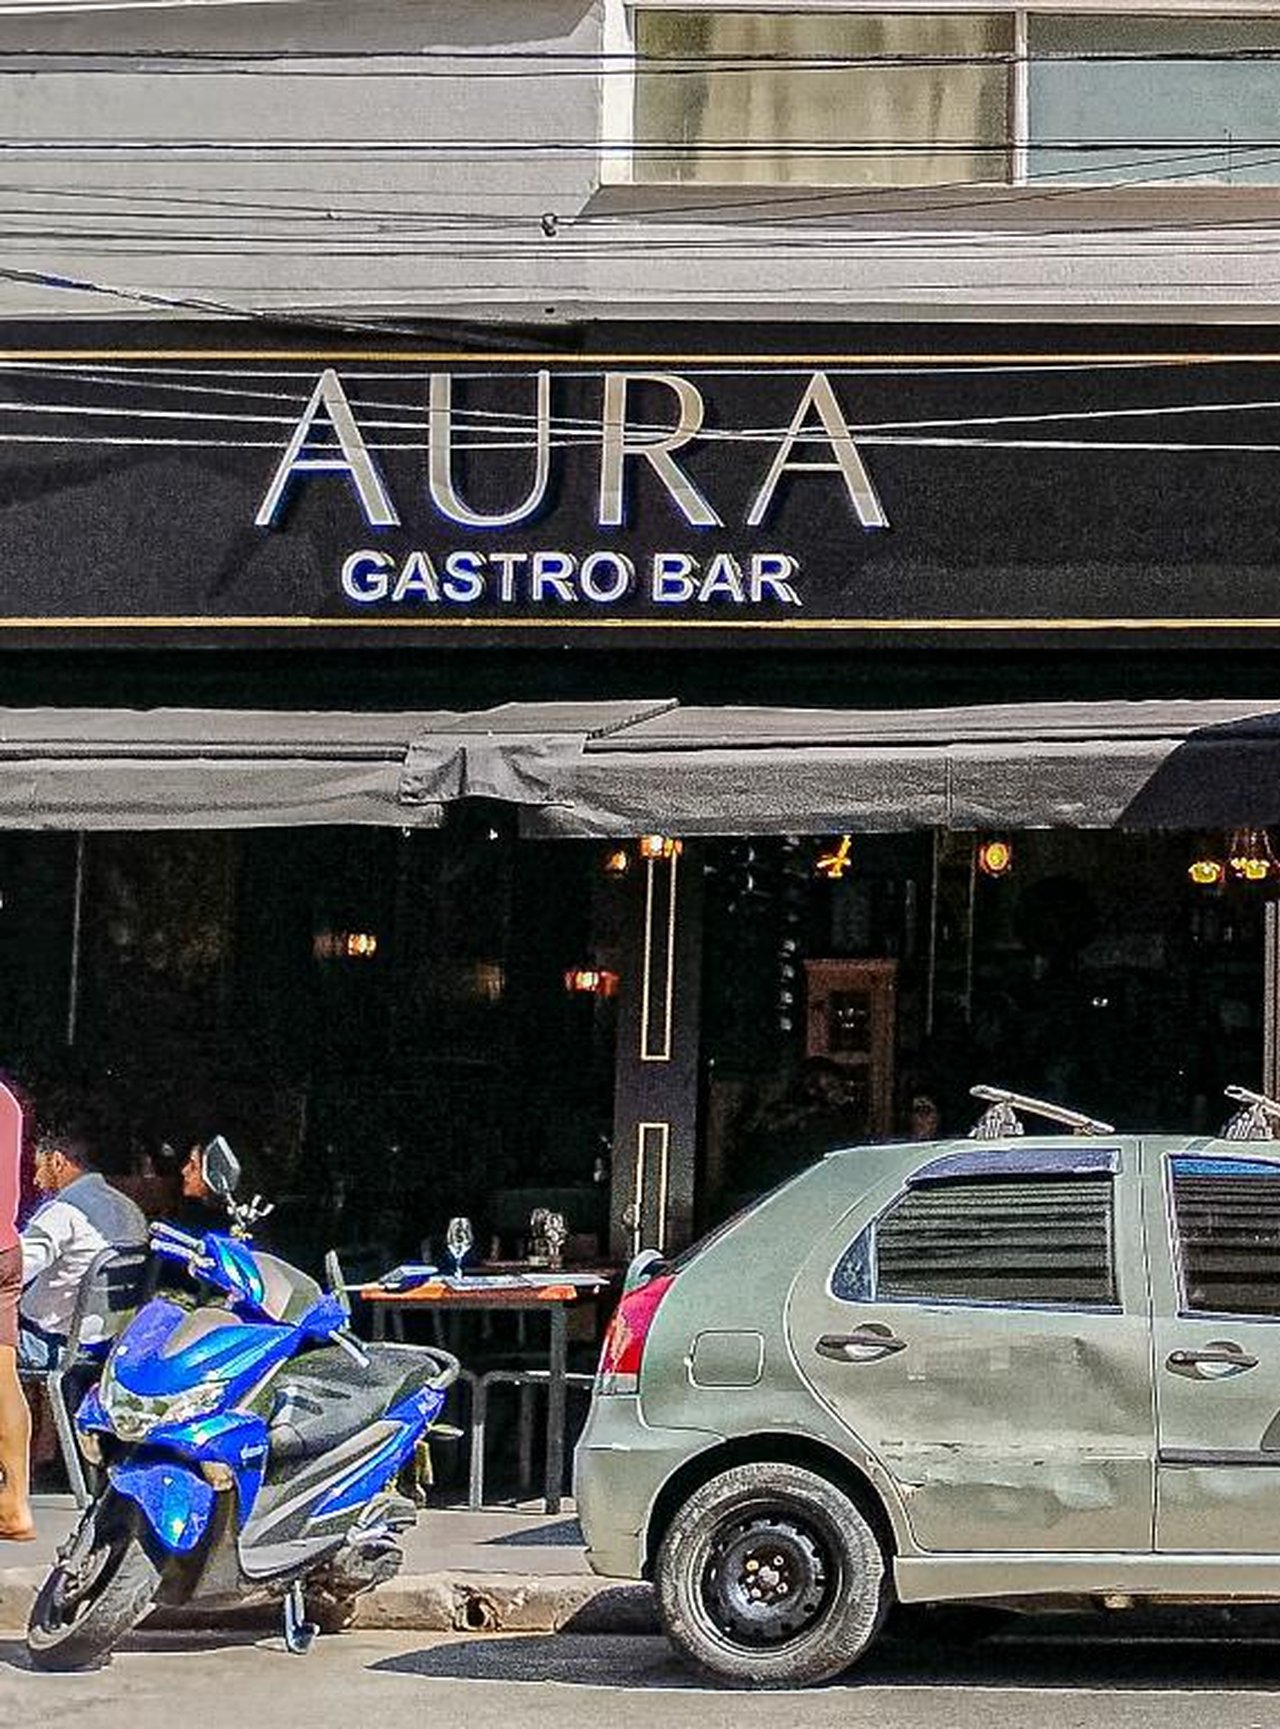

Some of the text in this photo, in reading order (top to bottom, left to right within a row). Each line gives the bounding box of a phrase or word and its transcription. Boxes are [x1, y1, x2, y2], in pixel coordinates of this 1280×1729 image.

[254, 369, 889, 528] AURA
[340, 551, 802, 605] GASTRO BAR
